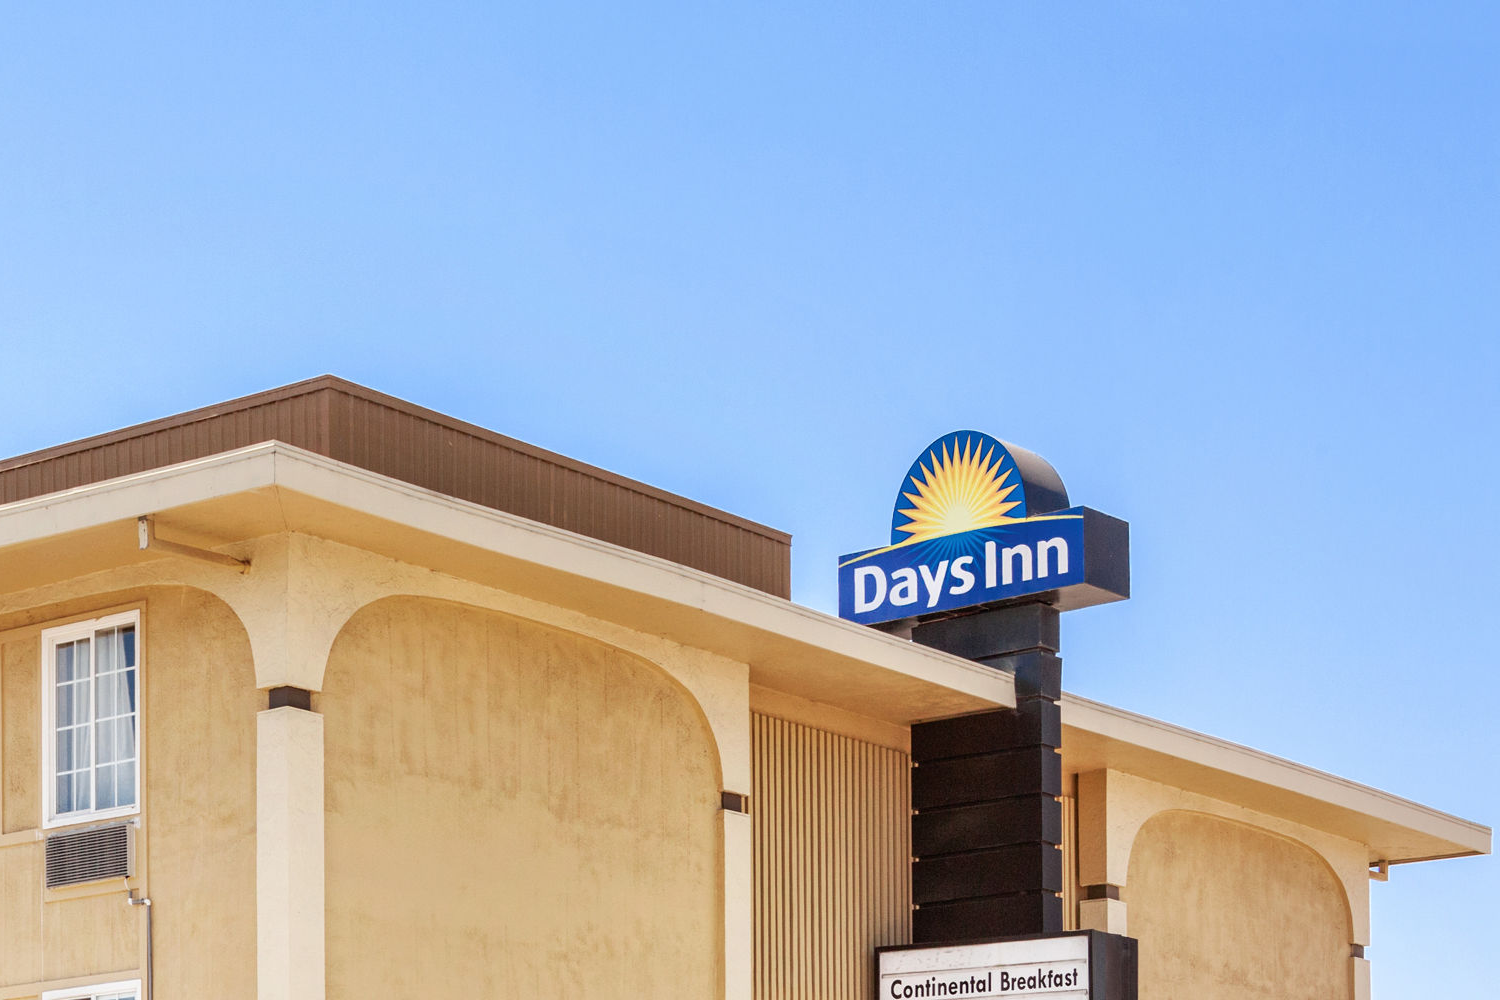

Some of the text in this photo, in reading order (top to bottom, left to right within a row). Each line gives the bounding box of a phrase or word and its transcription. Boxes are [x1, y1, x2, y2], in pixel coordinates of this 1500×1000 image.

[853, 536, 1069, 614] Days Inn
[890, 968, 1079, 1000] Continental Breakfast
